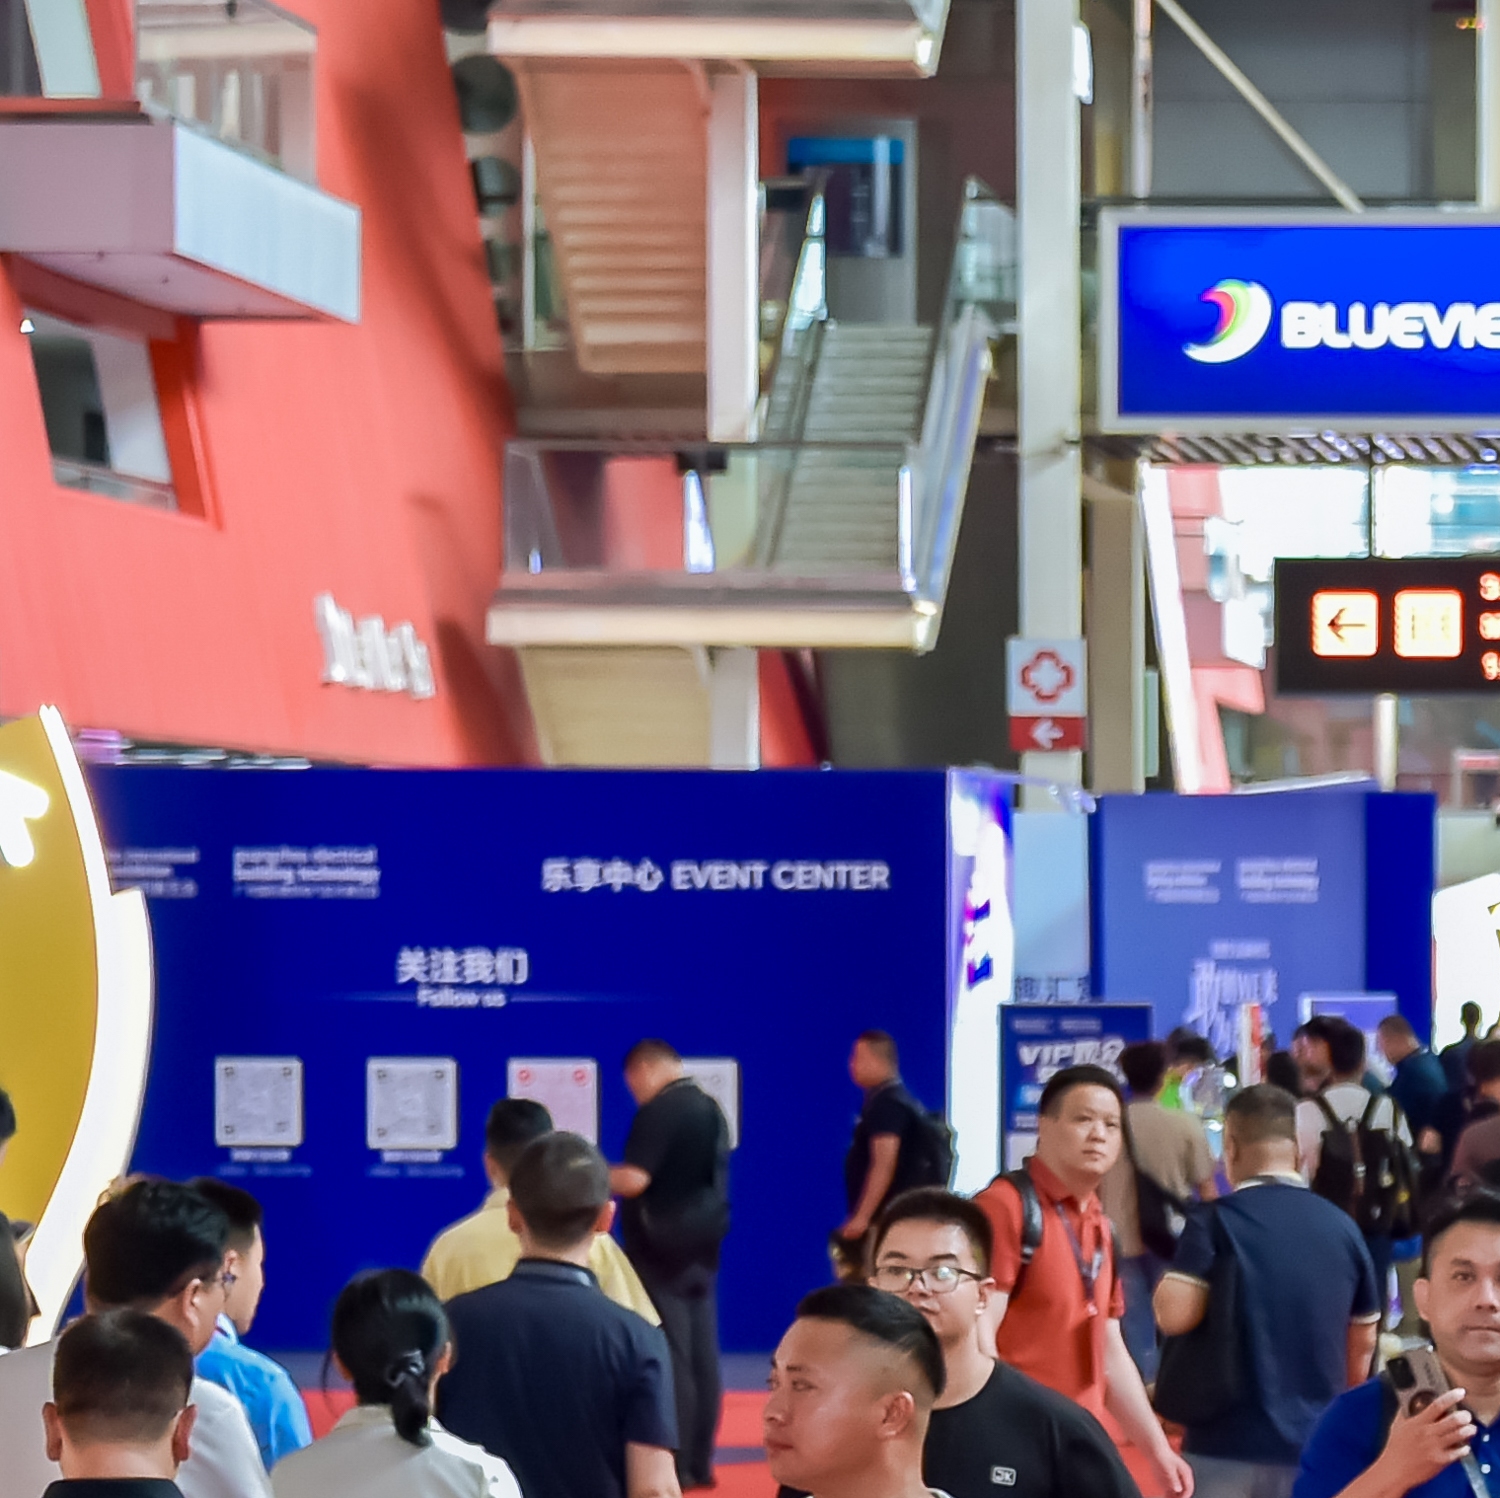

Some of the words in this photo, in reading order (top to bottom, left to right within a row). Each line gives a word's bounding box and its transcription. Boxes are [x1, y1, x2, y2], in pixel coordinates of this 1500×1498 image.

[671, 860, 769, 890] EVENT
[770, 860, 890, 890] CENTER
[396, 946, 528, 985] 关注我们
[417, 985, 479, 1008] Follow
